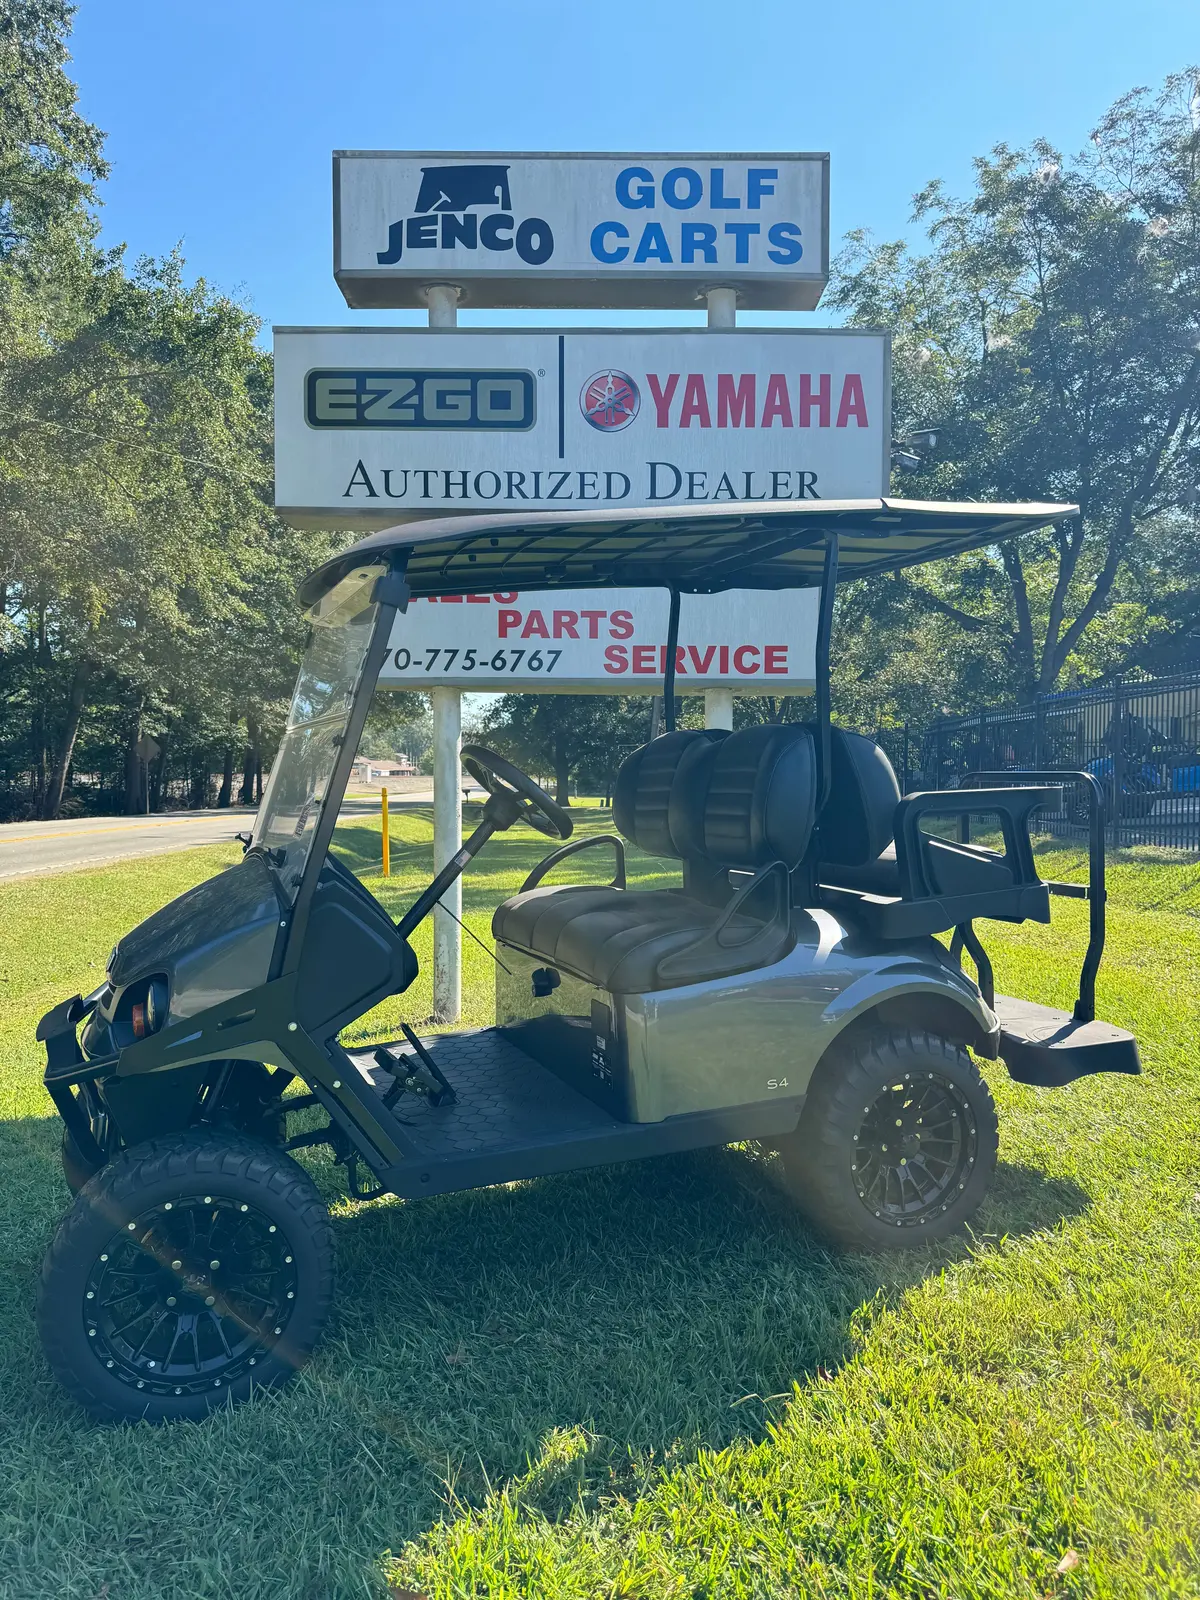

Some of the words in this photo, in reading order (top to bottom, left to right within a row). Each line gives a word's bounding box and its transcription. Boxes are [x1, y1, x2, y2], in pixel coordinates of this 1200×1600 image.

[614, 166, 780, 211] GOLF
[376, 213, 555, 266] JENCO
[589, 220, 804, 266] CARTS
[315, 377, 525, 422] EZGO
[646, 373, 869, 429] YAMAHA
[341, 458, 631, 500] AUTHORIZED
[645, 461, 823, 500] DEALER
[497, 609, 634, 640] PARTS
[603, 644, 789, 675] SERVICE
[766, 1077, 789, 1090] S4
